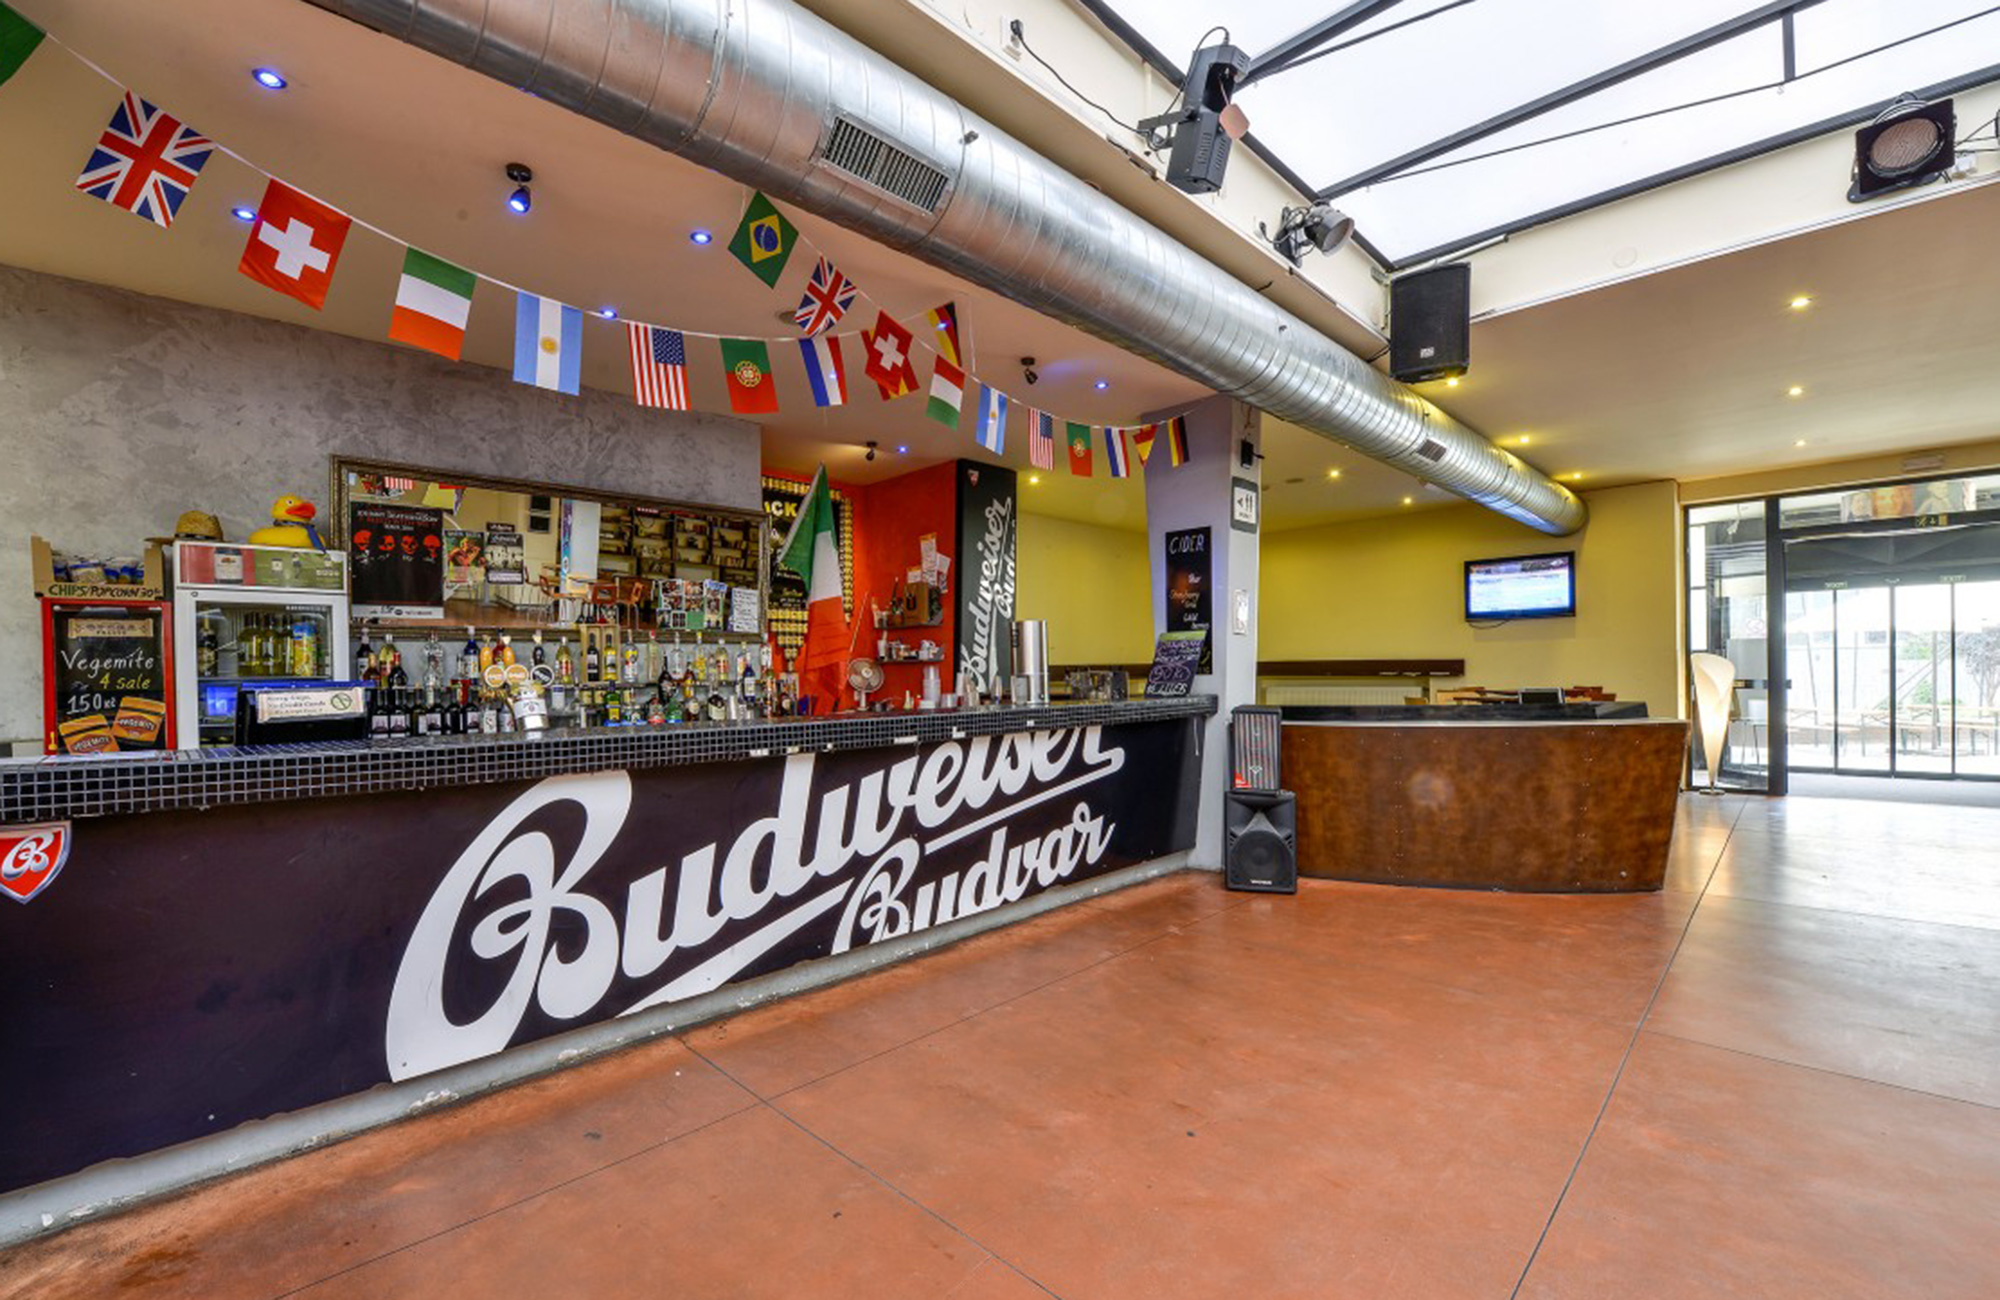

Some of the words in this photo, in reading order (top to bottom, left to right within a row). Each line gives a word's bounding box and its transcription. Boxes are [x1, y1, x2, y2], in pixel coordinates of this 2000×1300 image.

[1169, 534, 1205, 554] CIDER
[961, 497, 1011, 693] Budweiser
[61, 648, 154, 679] Vegemite
[100, 673, 110, 689] 4
[116, 674, 151, 690] sale
[385, 727, 1125, 1083] Budweiser
[831, 803, 1115, 955] Budvar
